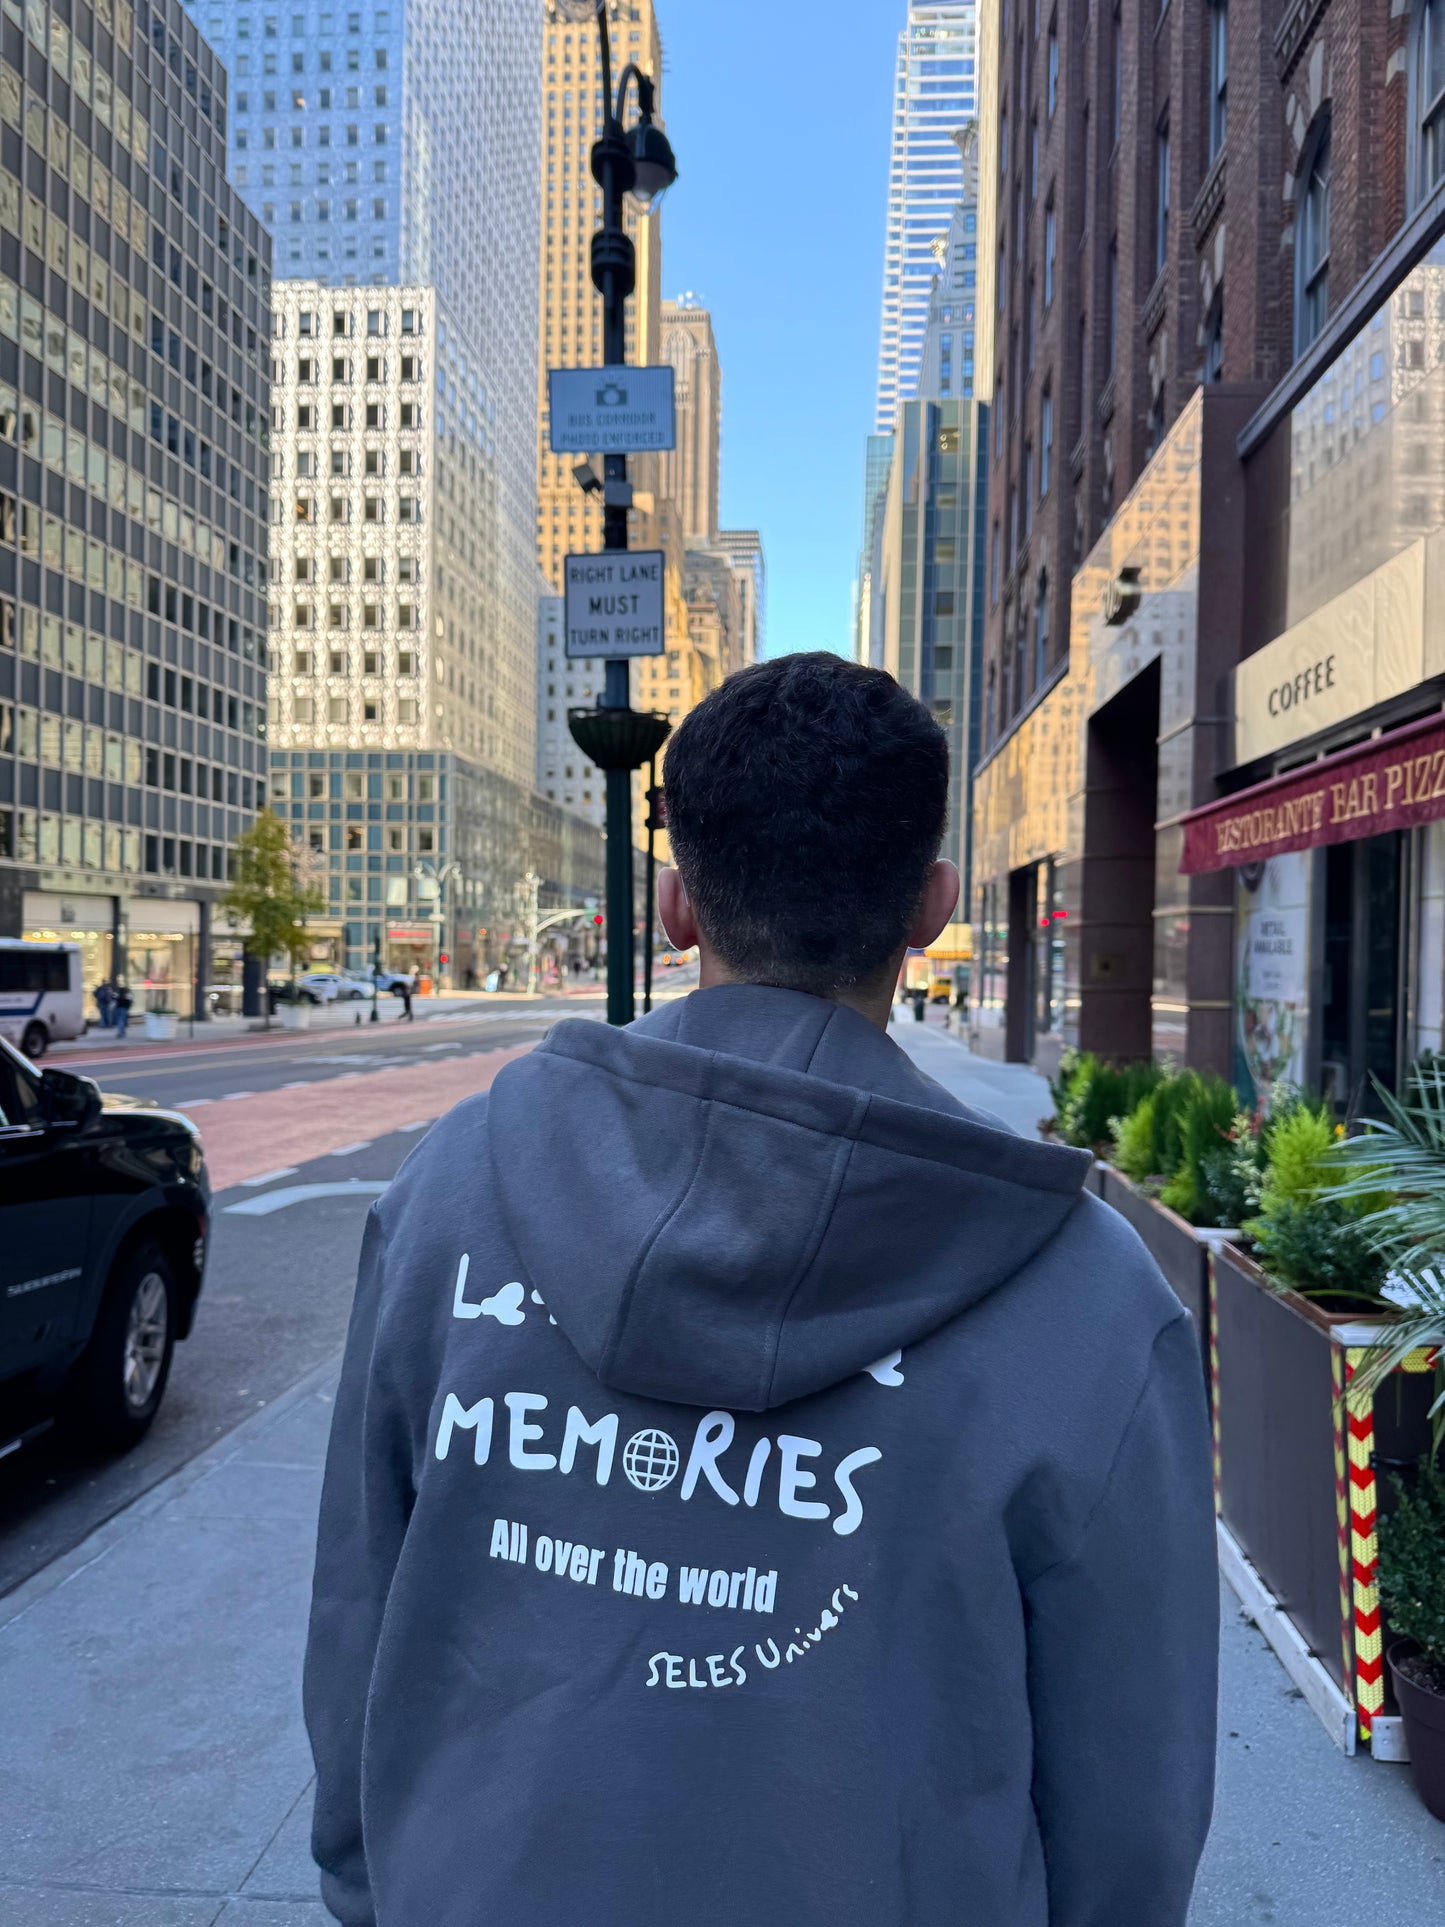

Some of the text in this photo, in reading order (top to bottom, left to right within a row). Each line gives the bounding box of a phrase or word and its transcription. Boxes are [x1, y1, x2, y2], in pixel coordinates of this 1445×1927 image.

[604, 432, 665, 444] ENFORCED
[570, 564, 659, 584] RIGHT LANE
[588, 595, 638, 615] MUST
[571, 626, 659, 645] TURN RIGHT
[1268, 655, 1335, 717] COFFEE
[1330, 772, 1379, 824] BAR
[489, 1518, 778, 1614] All over the world
[646, 1645, 747, 1688] SELES
